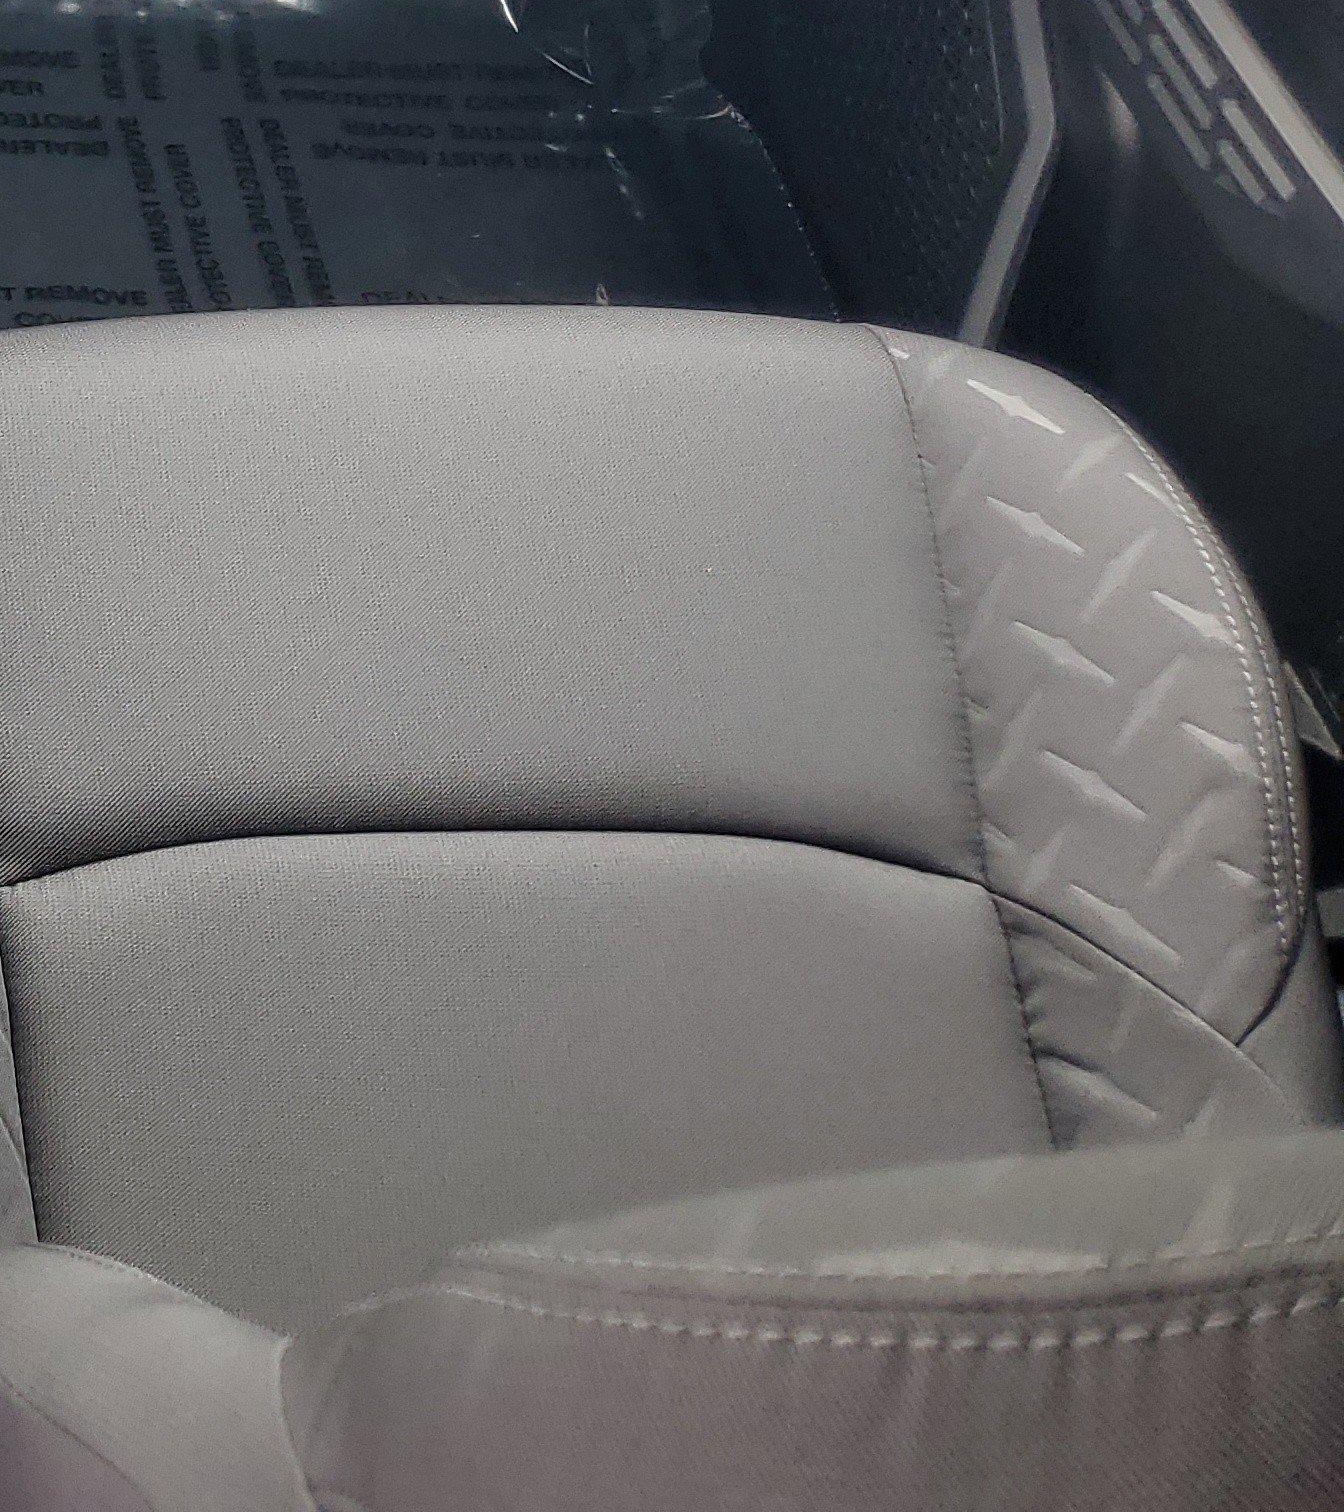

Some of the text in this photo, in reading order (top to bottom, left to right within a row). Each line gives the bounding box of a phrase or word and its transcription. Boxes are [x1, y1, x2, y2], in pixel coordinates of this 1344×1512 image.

[279, 89, 453, 110] PROTECTIVE
[0, 139, 109, 156] DEALER
[164, 143, 203, 210] COVER
[220, 117, 274, 234] PROTECTIVE
[116, 115, 195, 313] EALER MUST REMOVE
[258, 118, 303, 192] DEALER
[283, 194, 319, 251] MUST
[25, 285, 149, 307] REMOVE
